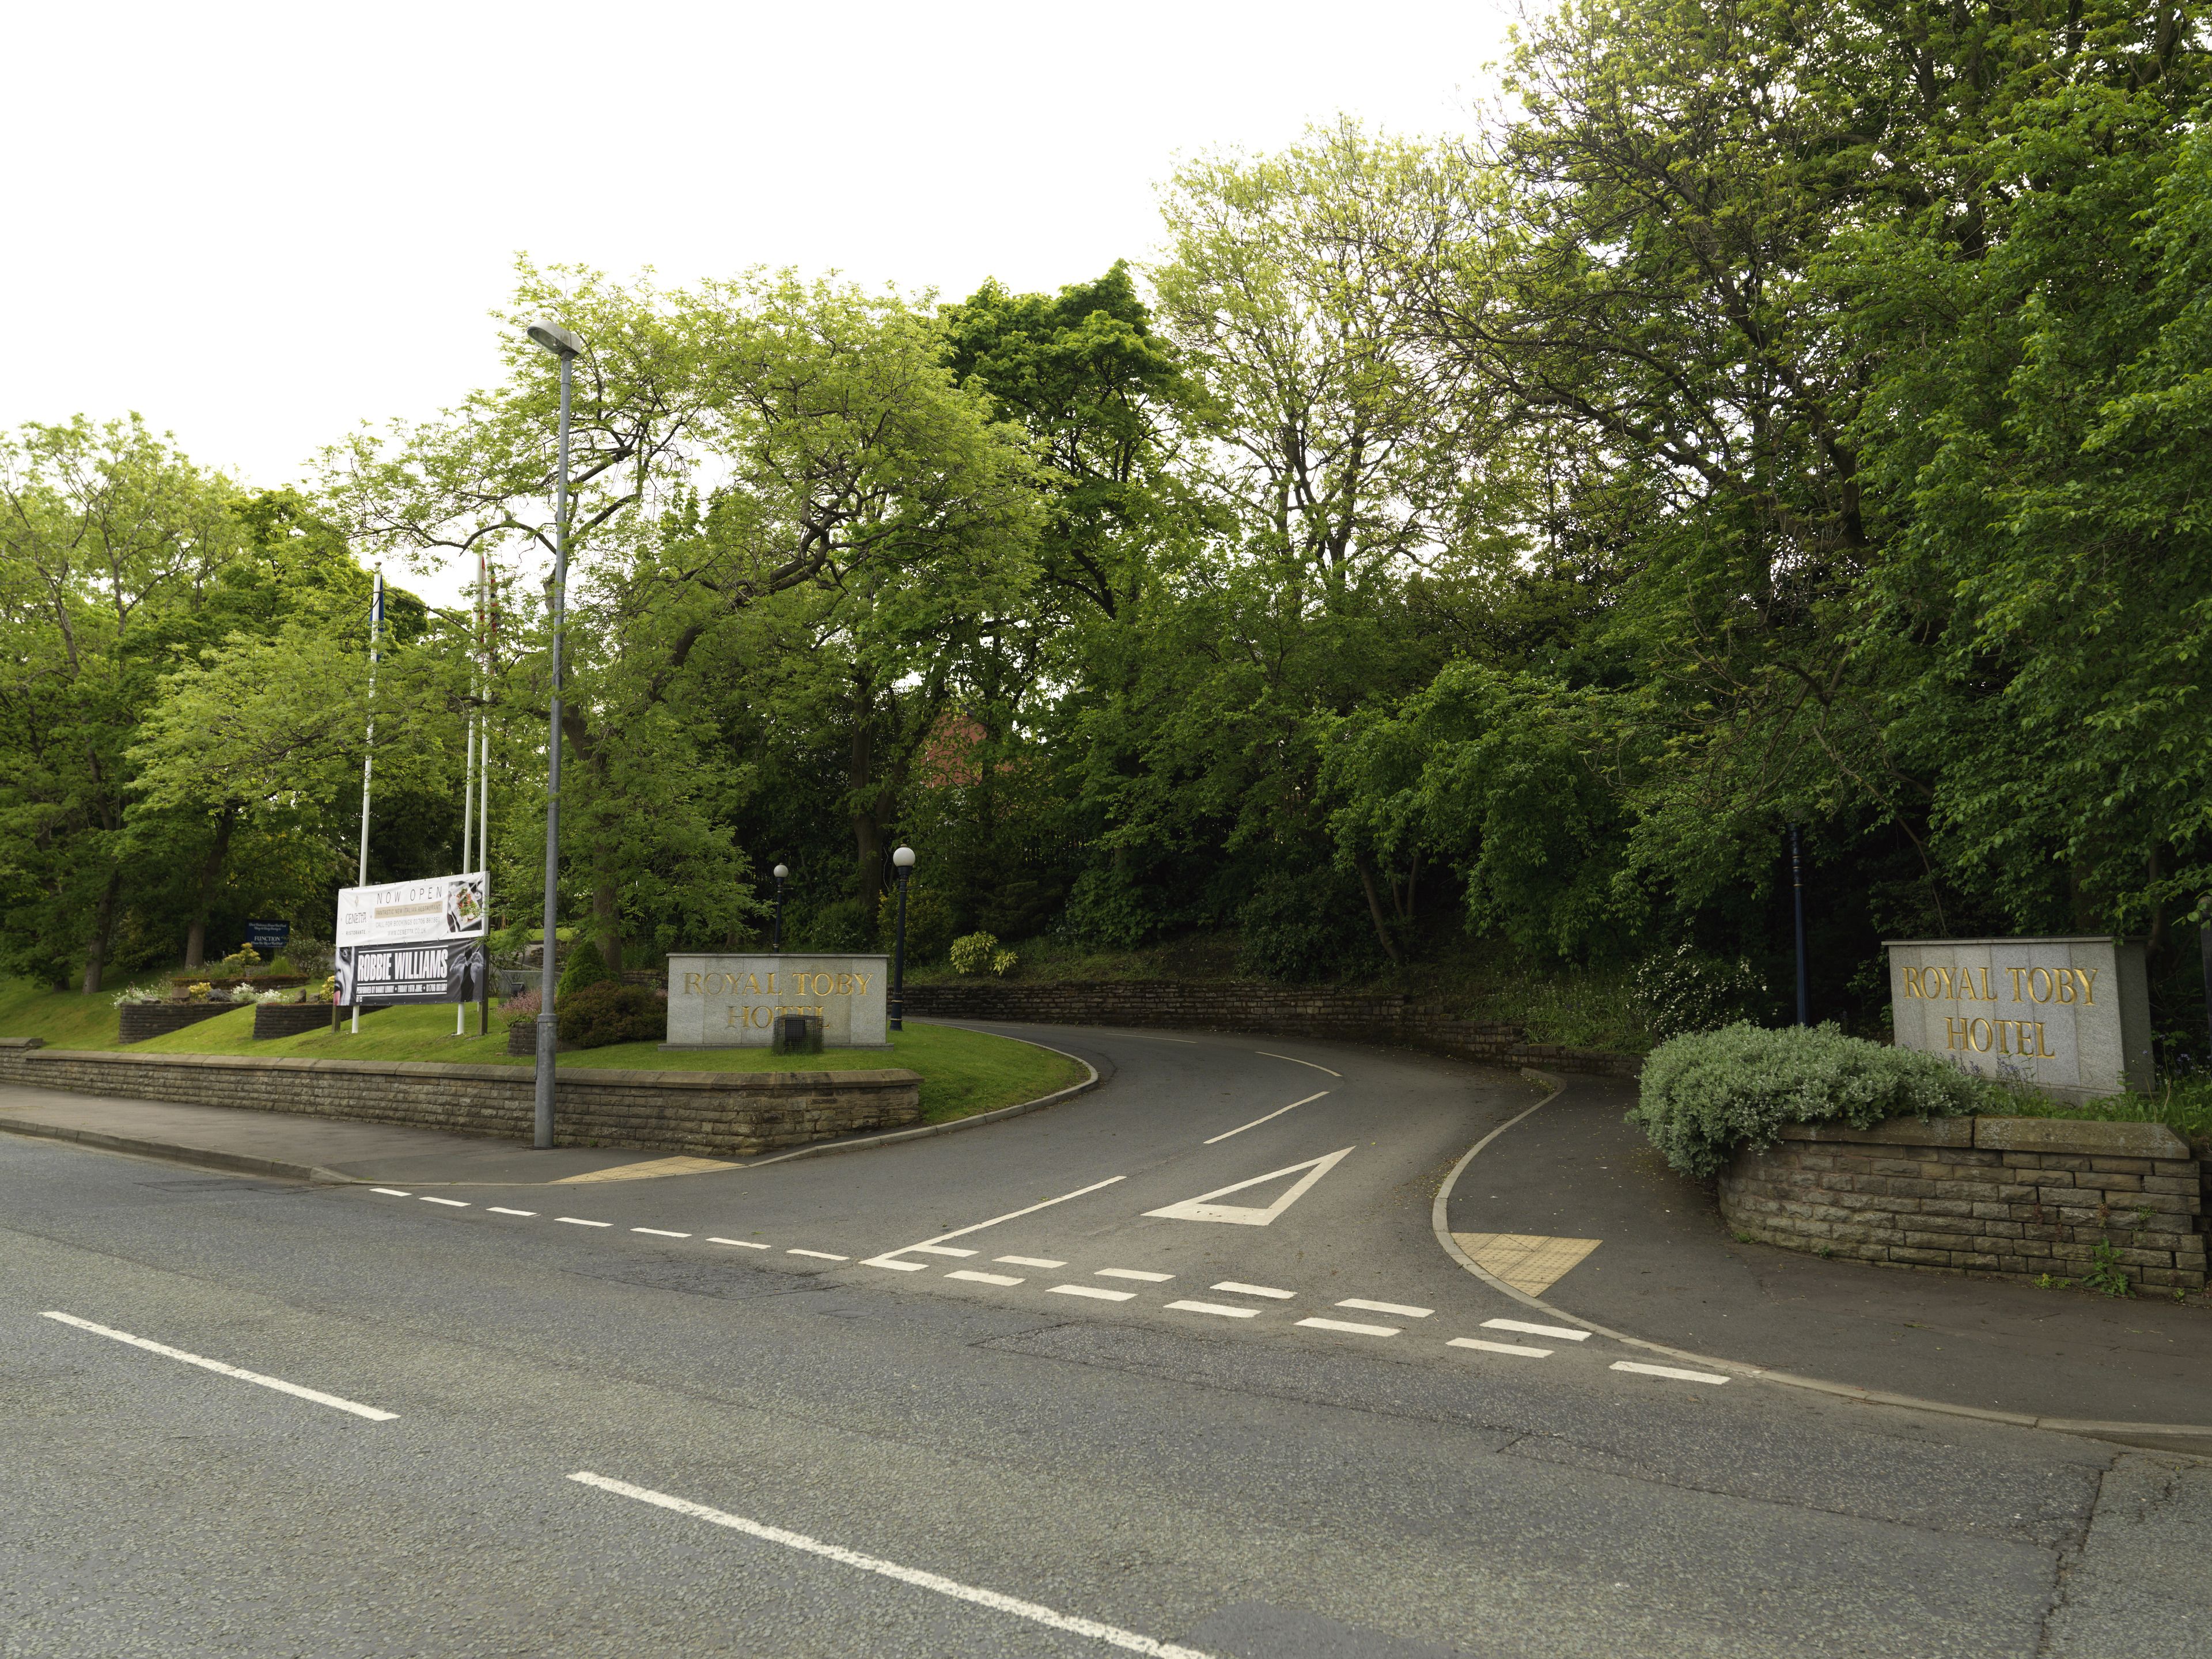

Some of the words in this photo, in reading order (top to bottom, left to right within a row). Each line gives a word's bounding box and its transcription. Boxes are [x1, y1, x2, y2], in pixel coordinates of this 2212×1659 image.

[377, 891, 402, 904] NOW
[410, 886, 442, 901] OPEN
[418, 904, 441, 912] RESTAURANT
[393, 919, 412, 927] BOOKINGS
[357, 953, 392, 982] ROBBIE
[395, 949, 448, 980] WILLIAMS
[682, 972, 783, 996] ROYAL
[792, 972, 873, 996] TOBY
[1902, 966, 1998, 1002] ROYAL
[2005, 967, 2099, 1006] TOBY
[1944, 1017, 2055, 1059] HOTEL
